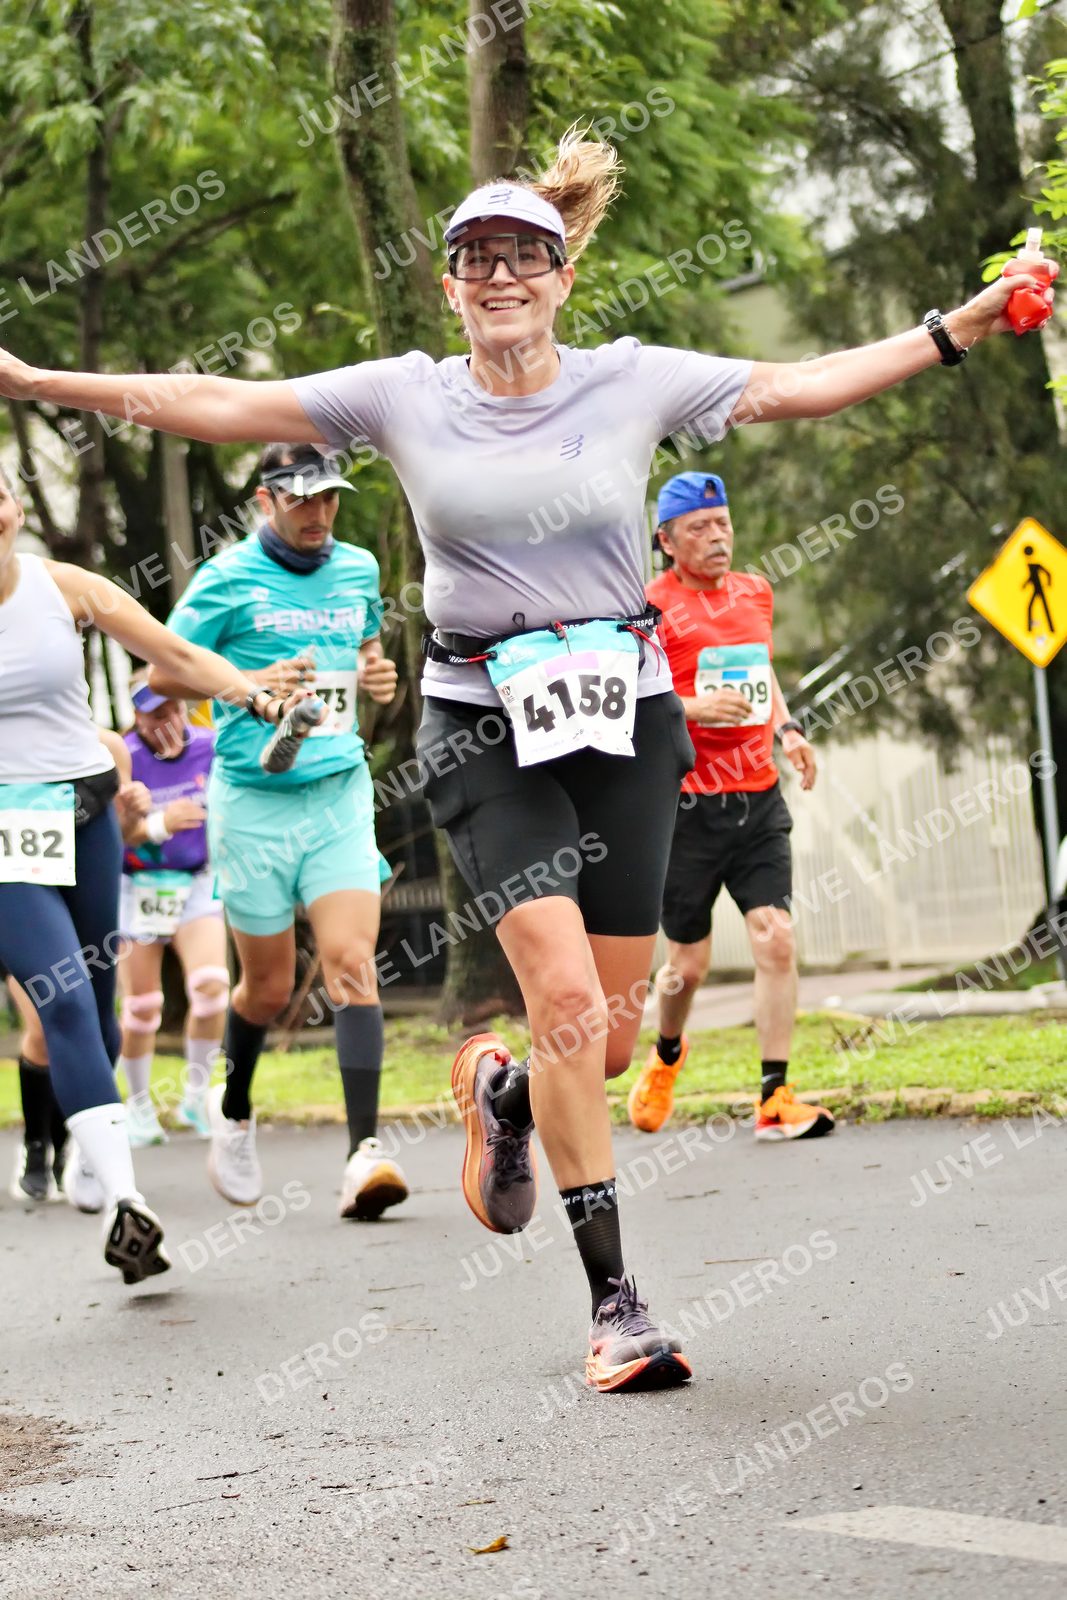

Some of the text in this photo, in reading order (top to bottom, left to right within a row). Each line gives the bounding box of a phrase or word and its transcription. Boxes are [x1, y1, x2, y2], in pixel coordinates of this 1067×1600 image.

[523, 674, 627, 733] 4158
[704, 681, 767, 704] 09
[0, 828, 66, 859] 182
